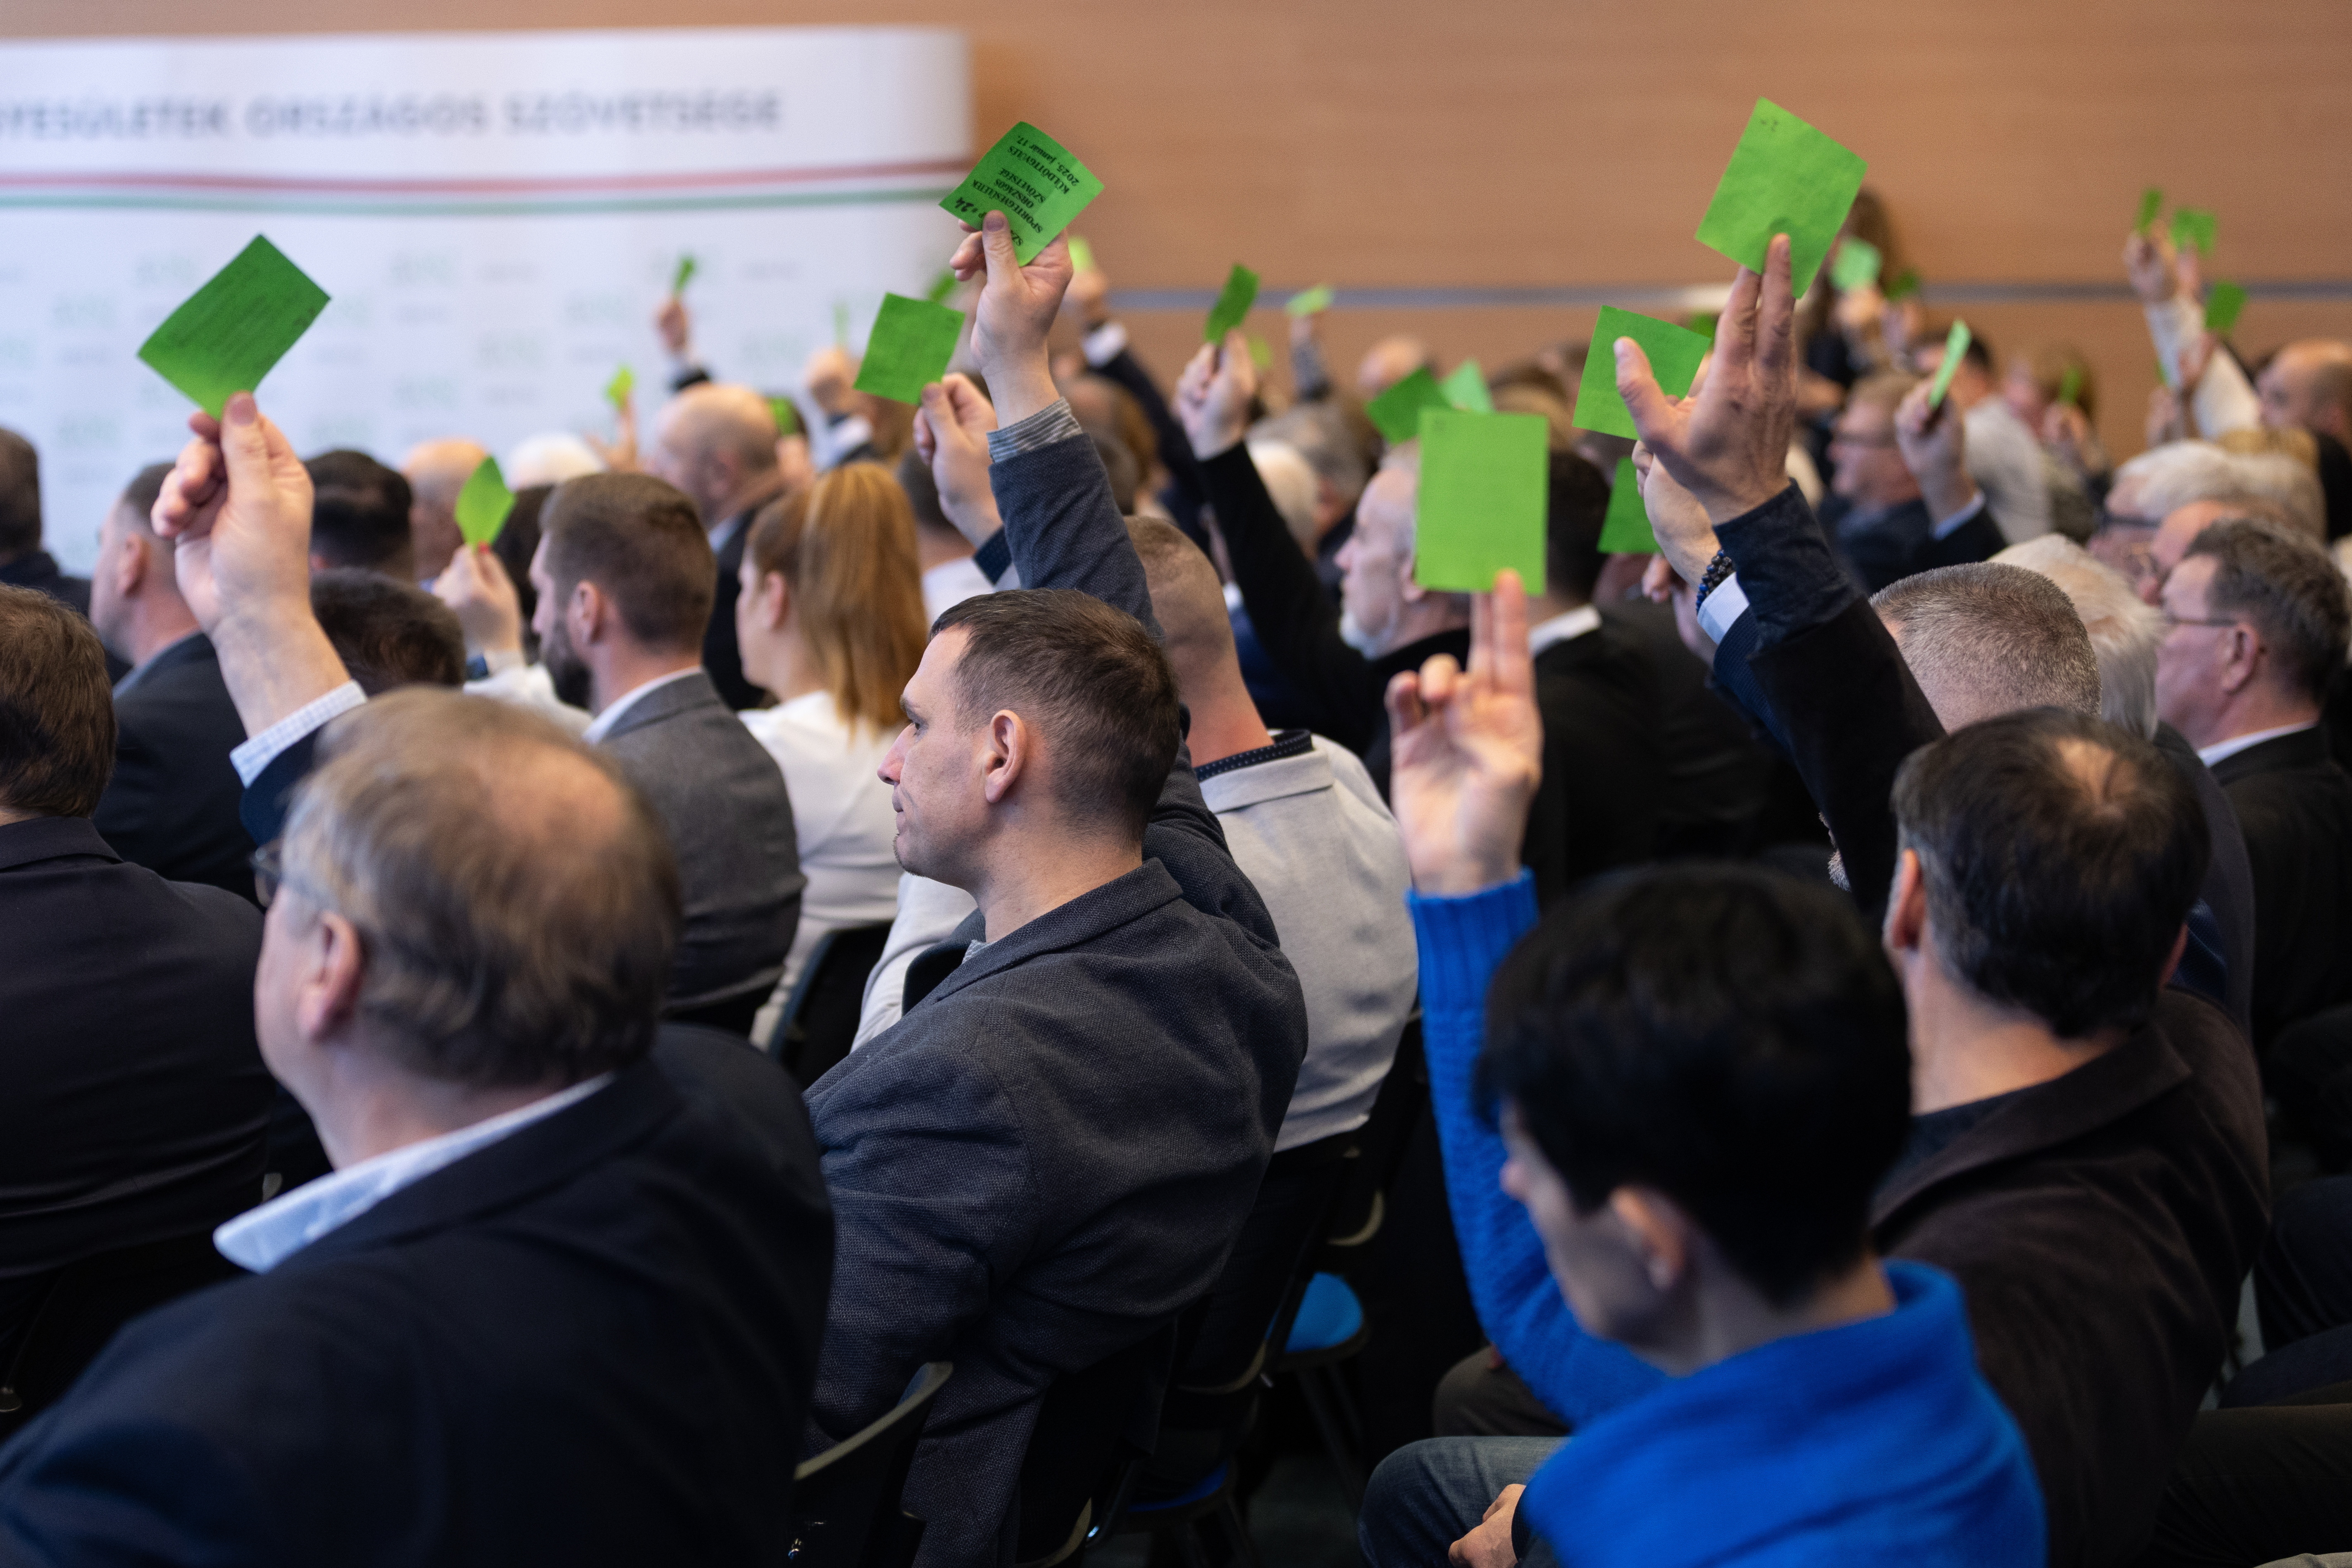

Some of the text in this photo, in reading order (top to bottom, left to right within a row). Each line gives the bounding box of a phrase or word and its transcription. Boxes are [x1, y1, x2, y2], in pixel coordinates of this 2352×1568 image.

[0, 92, 226, 138] YESÜLETEK
[1056, 162, 1079, 186] 2025.
[972, 179, 1043, 234] SPORTEGYESÜLETEK
